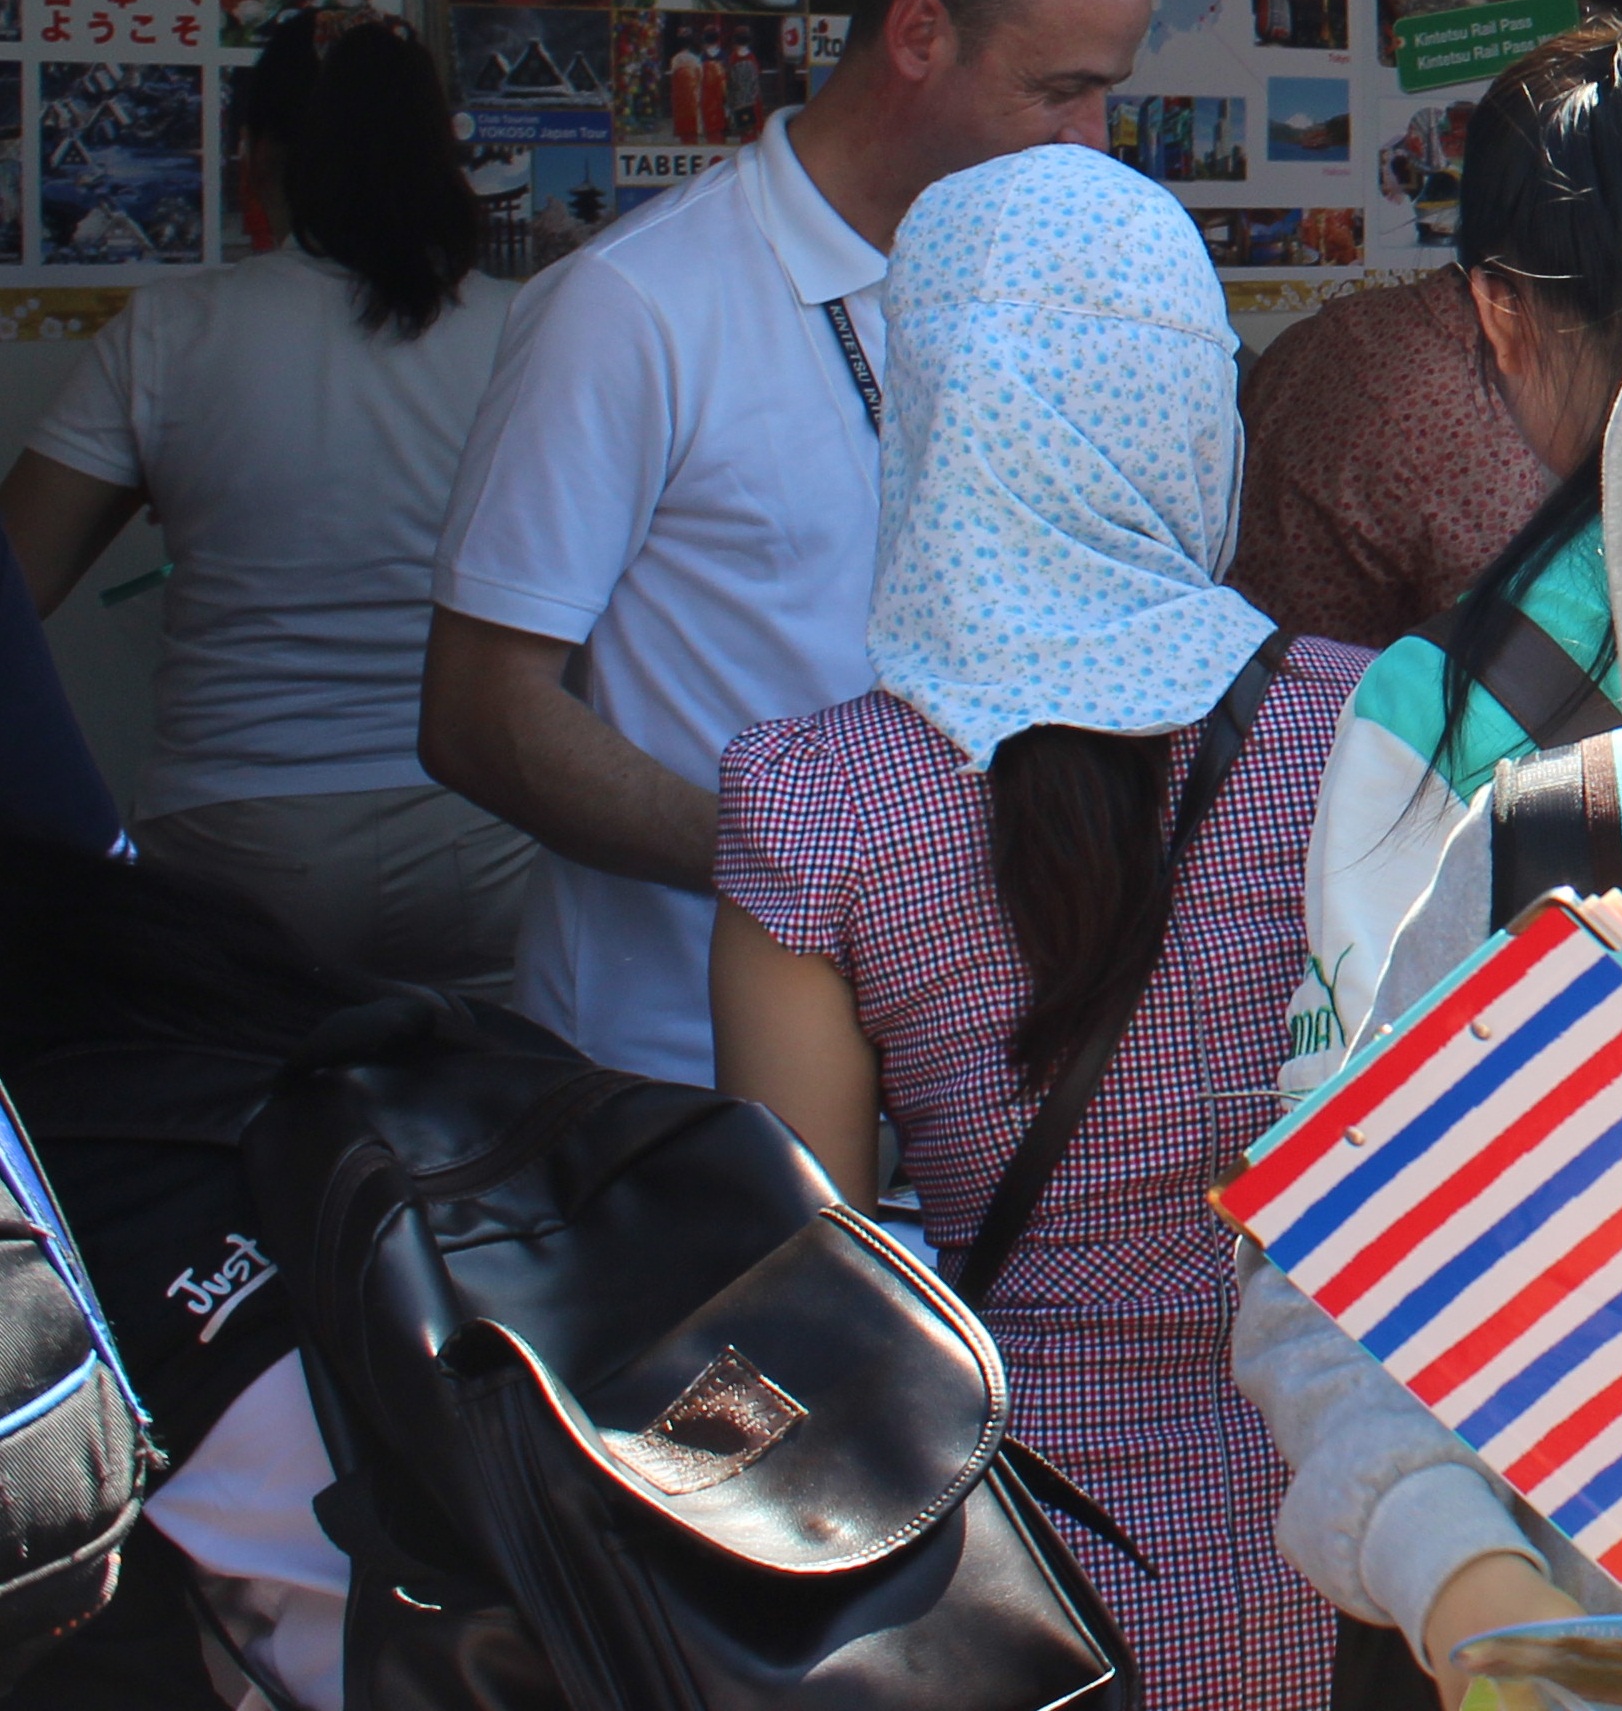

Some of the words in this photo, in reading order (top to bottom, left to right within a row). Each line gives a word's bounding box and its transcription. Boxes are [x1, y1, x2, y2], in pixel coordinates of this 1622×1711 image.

[41, 11, 201, 46] ようこそ
[1414, 29, 1469, 48] Kintetsu
[1470, 19, 1497, 37] Rail
[1500, 16, 1533, 33] Pass
[1416, 51, 1472, 71] Kintetsu
[1473, 43, 1499, 60] Rail
[1503, 38, 1535, 54] Pass
[478, 126, 537, 140] YOKOSO
[540, 127, 578, 142] Japan
[580, 127, 608, 139] Tour
[619, 154, 703, 176] TABEE
[167, 1233, 271, 1315] Just
